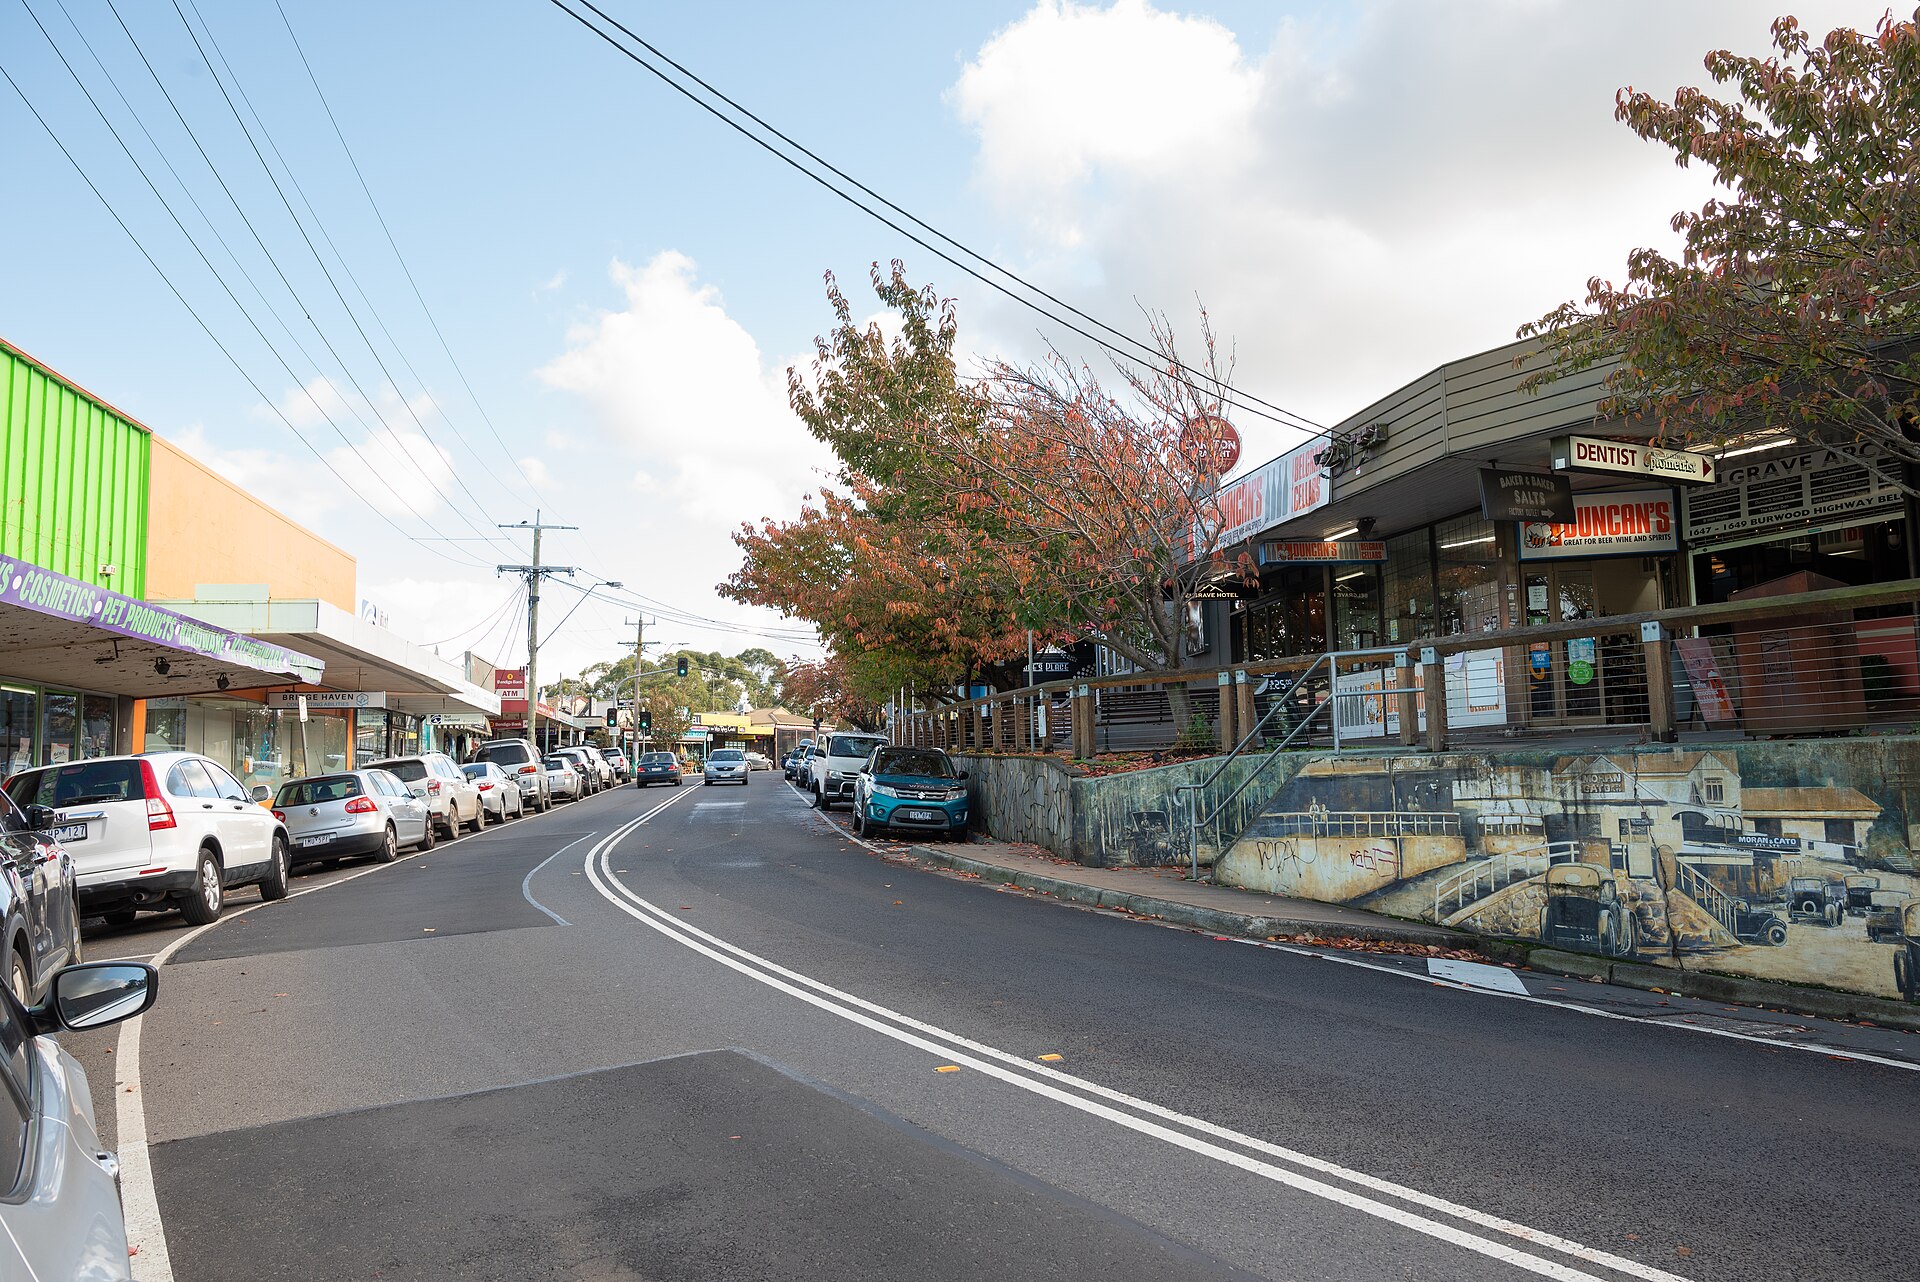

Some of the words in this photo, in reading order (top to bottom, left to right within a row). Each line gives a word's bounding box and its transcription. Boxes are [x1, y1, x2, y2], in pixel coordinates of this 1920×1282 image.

[1576, 442, 1637, 467] DENTIST
[1500, 475, 1523, 488] BAKER
[1531, 475, 1555, 492] BAKER
[1293, 474, 1321, 513] CELLARS
[1514, 489, 1545, 506] SALTS
[1689, 526, 1712, 537] 1647
[1723, 520, 1747, 531] 1649
[1750, 508, 1810, 526] BURWOOD
[1813, 497, 1874, 515] HIGHWAY
[1563, 537, 1583, 546] GREAT
[1584, 536, 1597, 545] FOR
[1598, 535, 1613, 544] BEER
[1615, 534, 1632, 543] WINE
[1634, 534, 1647, 542] AND
[1649, 532, 1671, 542] SPIRITS
[1293, 541, 1337, 557] DUNCAN'S
[1361, 551, 1382, 560] CELLARS
[19, 570, 96, 618] COSMETICS
[100, 596, 127, 625] PET
[122, 603, 177, 641] PRODUCTS
[68, 825, 85, 837] 127
